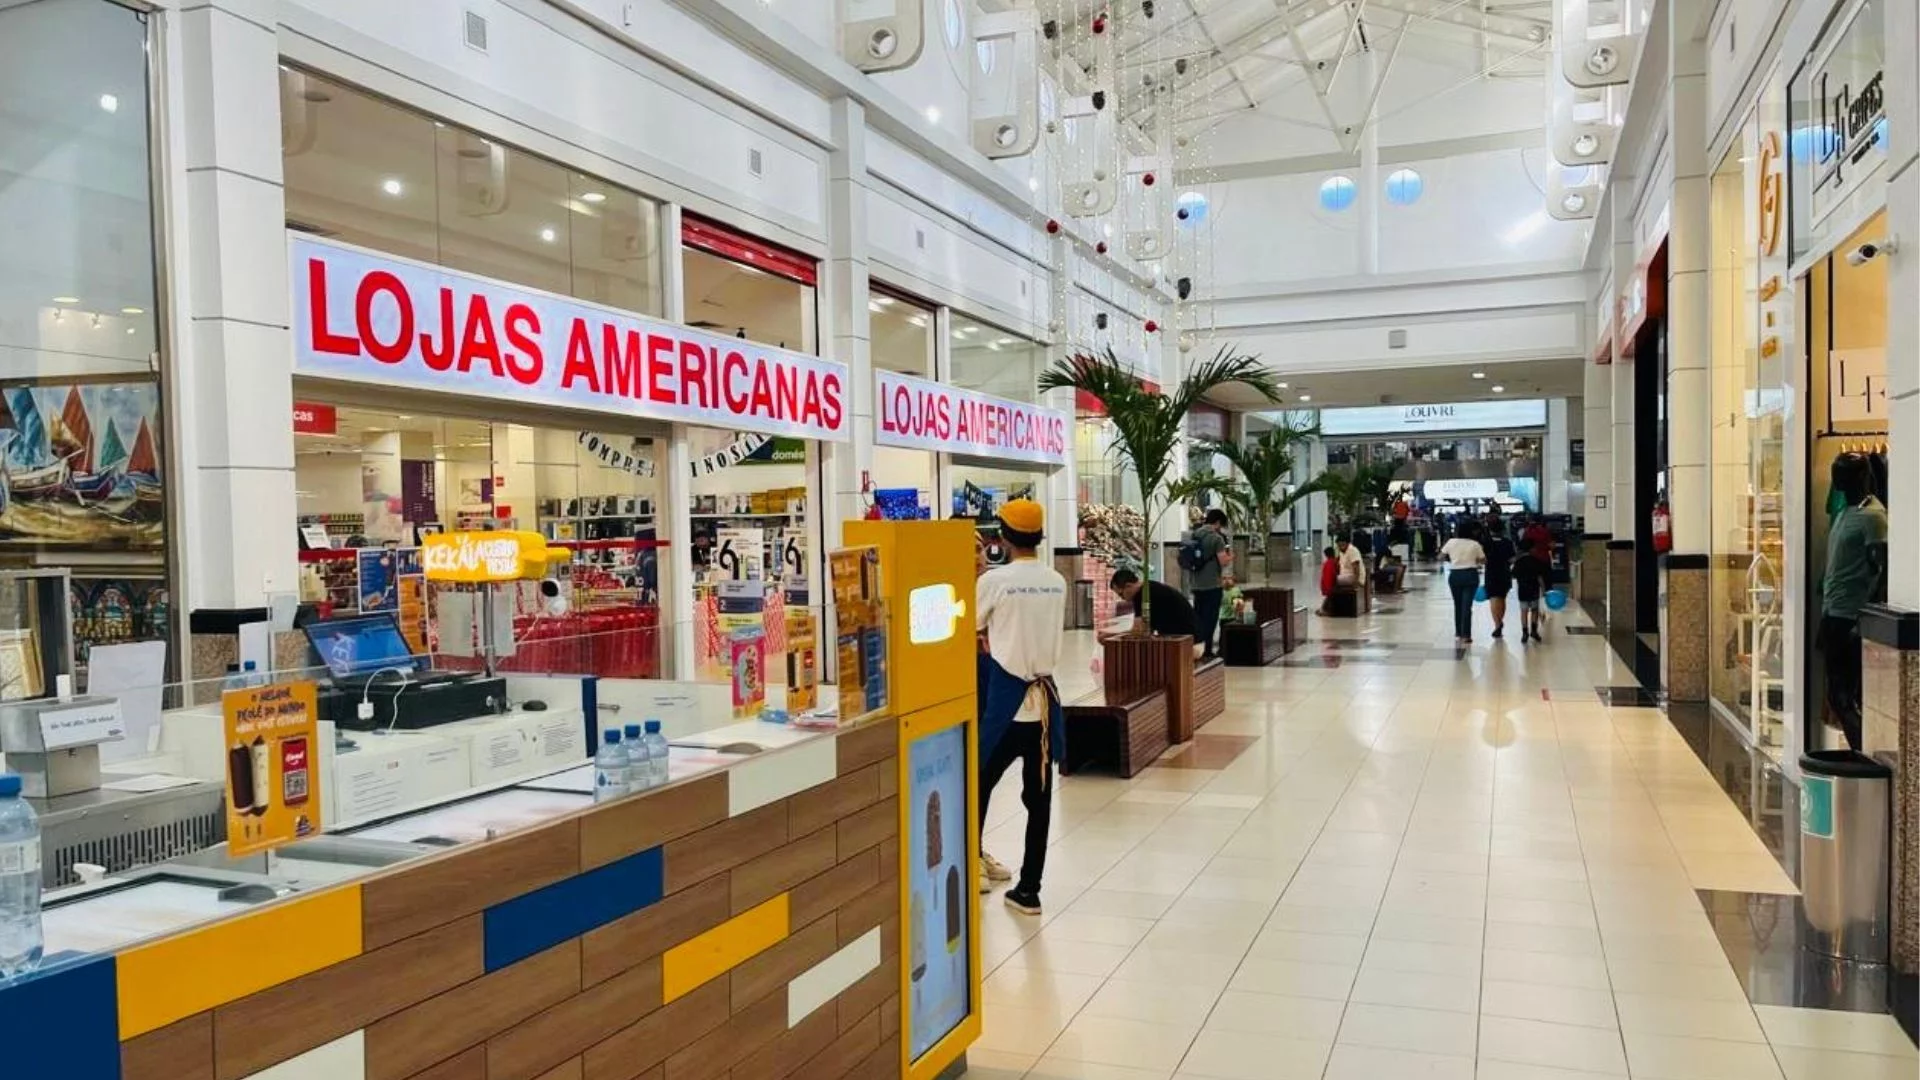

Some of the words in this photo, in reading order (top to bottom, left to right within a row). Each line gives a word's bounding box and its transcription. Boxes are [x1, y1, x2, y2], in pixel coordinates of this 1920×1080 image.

[308, 258, 544, 386] LOJAS
[560, 318, 844, 430] AMERICANAS
[881, 382, 950, 441] LOJAS
[957, 399, 1065, 455] AMERICANAS
[1405, 405, 1456, 418] LOUVRE
[578, 431, 644, 477] COMPRE
